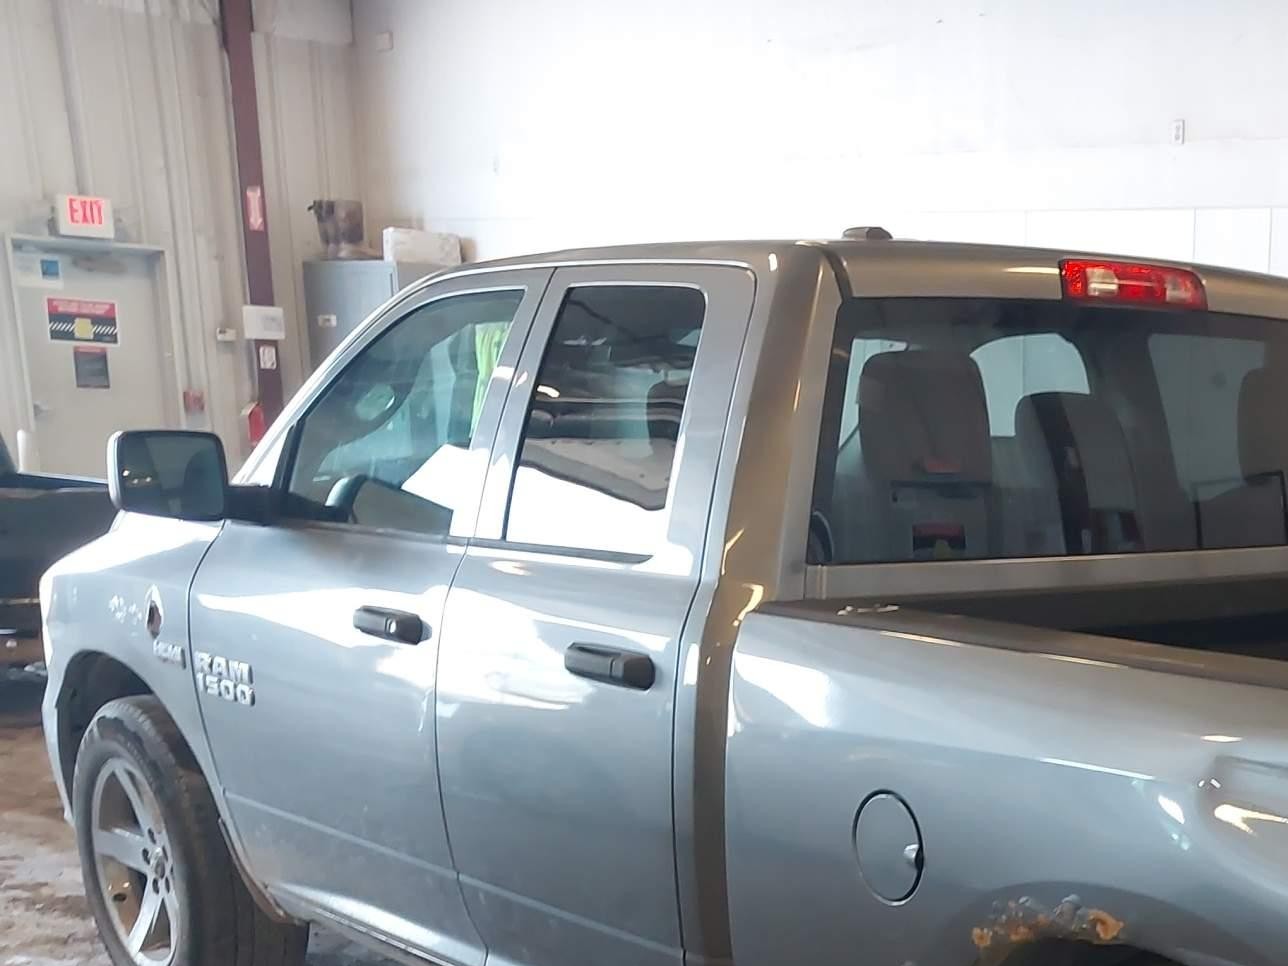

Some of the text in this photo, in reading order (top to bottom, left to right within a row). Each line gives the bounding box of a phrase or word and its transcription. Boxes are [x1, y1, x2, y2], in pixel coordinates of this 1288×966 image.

[68, 197, 104, 225] EXIT
[194, 651, 253, 685] RAM
[196, 671, 255, 706] 1500
